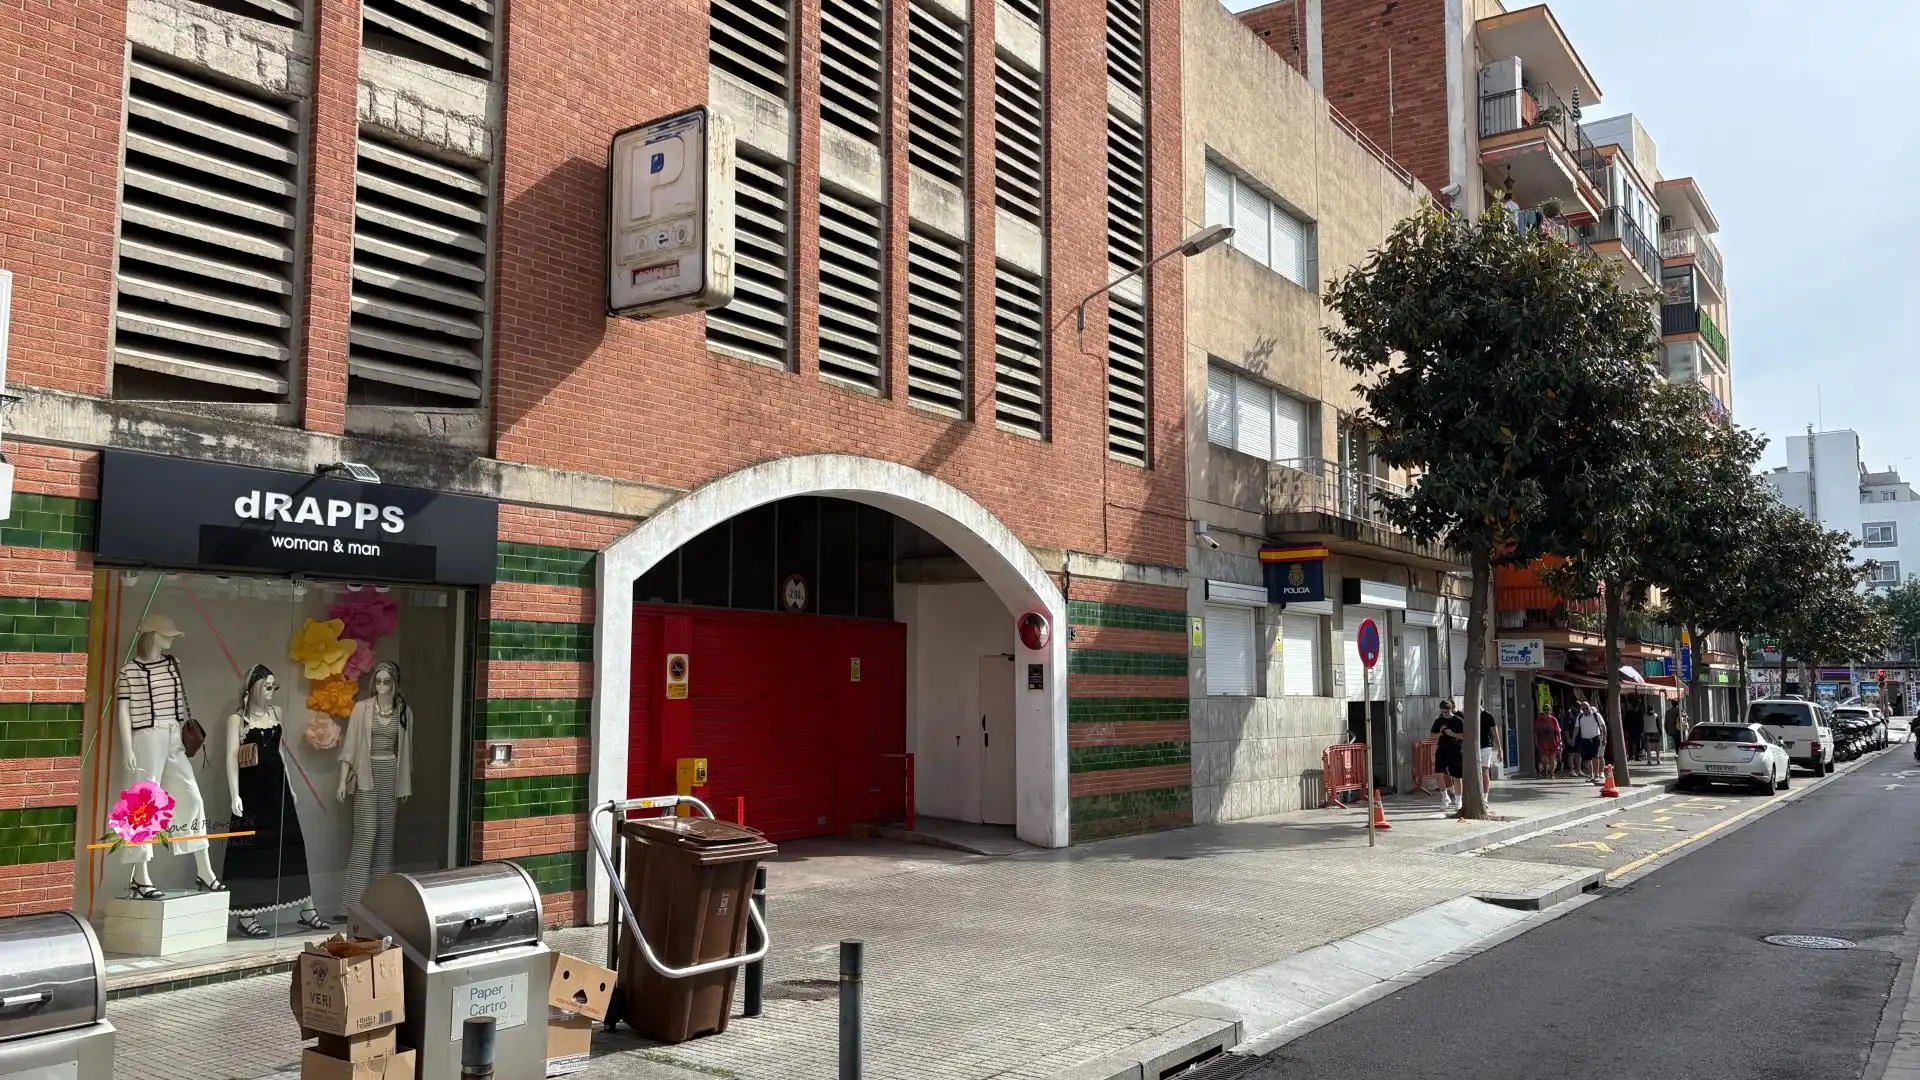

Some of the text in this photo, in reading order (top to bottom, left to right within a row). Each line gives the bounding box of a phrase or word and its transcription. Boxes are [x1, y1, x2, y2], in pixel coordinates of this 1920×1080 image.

[234, 490, 405, 533] dRAPPS
[272, 536, 380, 556] woman & man
[309, 991, 332, 1007] VERI
[470, 985, 504, 1000] Paper
[469, 996, 507, 1017] Cartró
